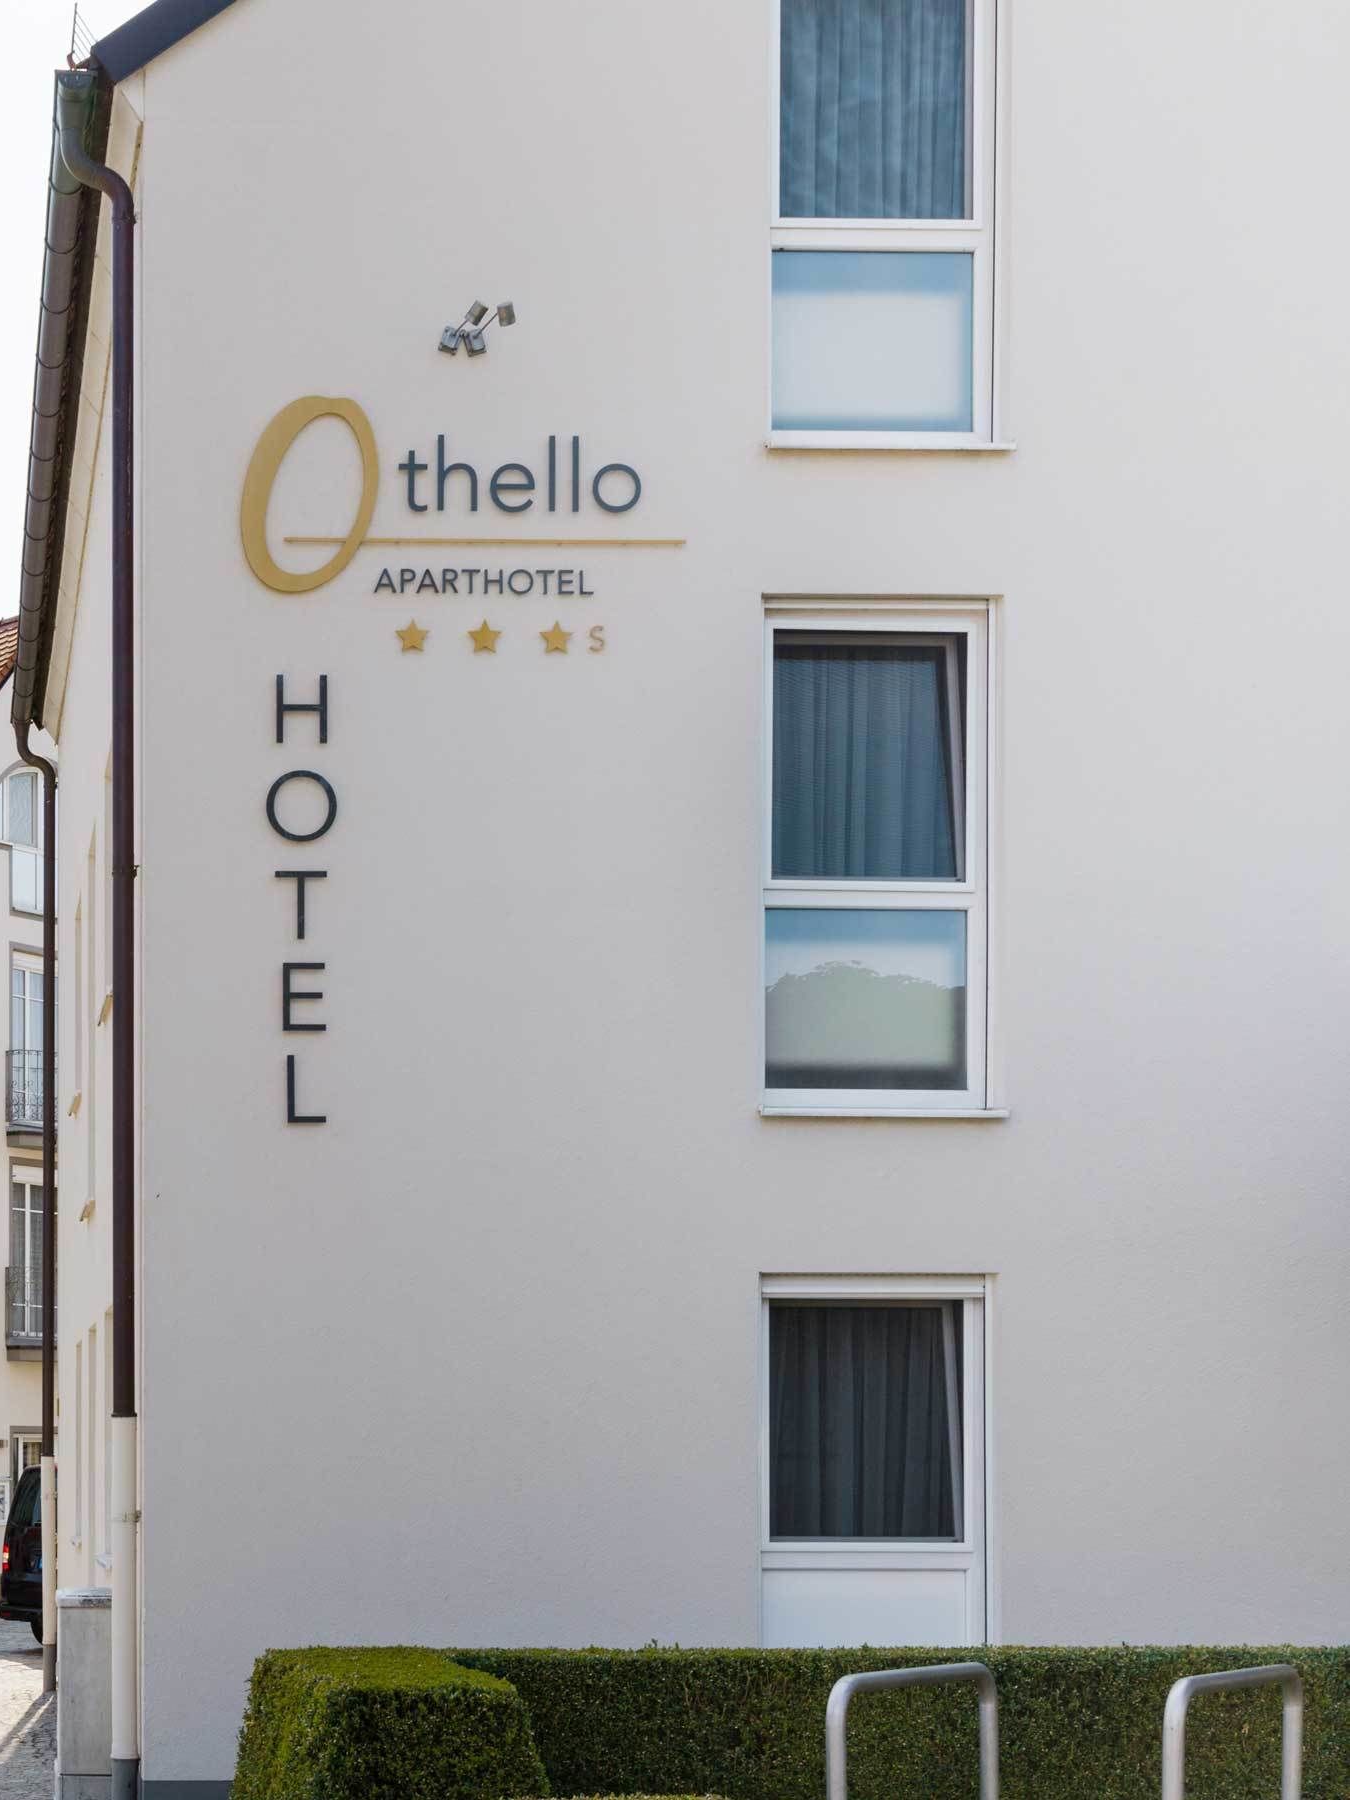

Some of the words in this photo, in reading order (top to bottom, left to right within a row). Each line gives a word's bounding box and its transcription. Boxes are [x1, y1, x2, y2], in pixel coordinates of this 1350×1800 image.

[240, 395, 643, 594] Othello
[373, 567, 595, 597] APARTHOTEL
[265, 674, 338, 1124] HOTEL
